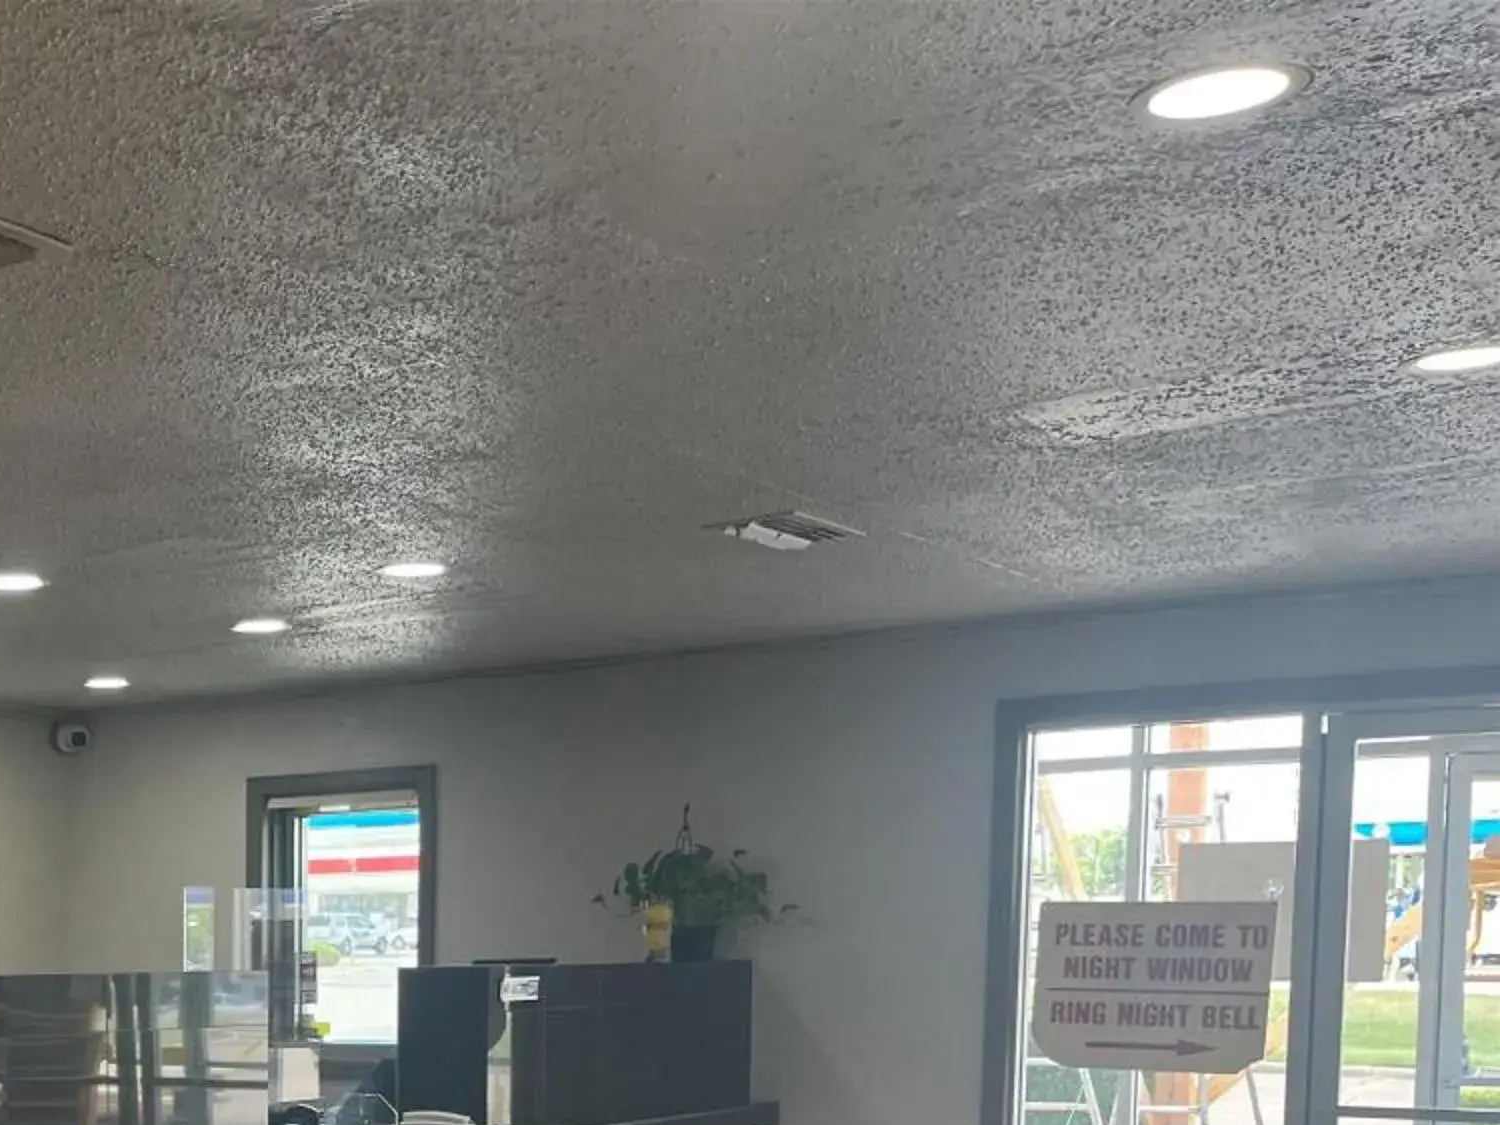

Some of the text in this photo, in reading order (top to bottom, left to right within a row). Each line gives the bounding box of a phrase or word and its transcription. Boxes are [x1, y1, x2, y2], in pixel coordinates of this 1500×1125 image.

[1055, 923, 1269, 950] PLEASE COME TO
[1063, 956, 1254, 983] NIGHT WINDOW
[1050, 1001, 1261, 1031] RING NIGHT BELL
